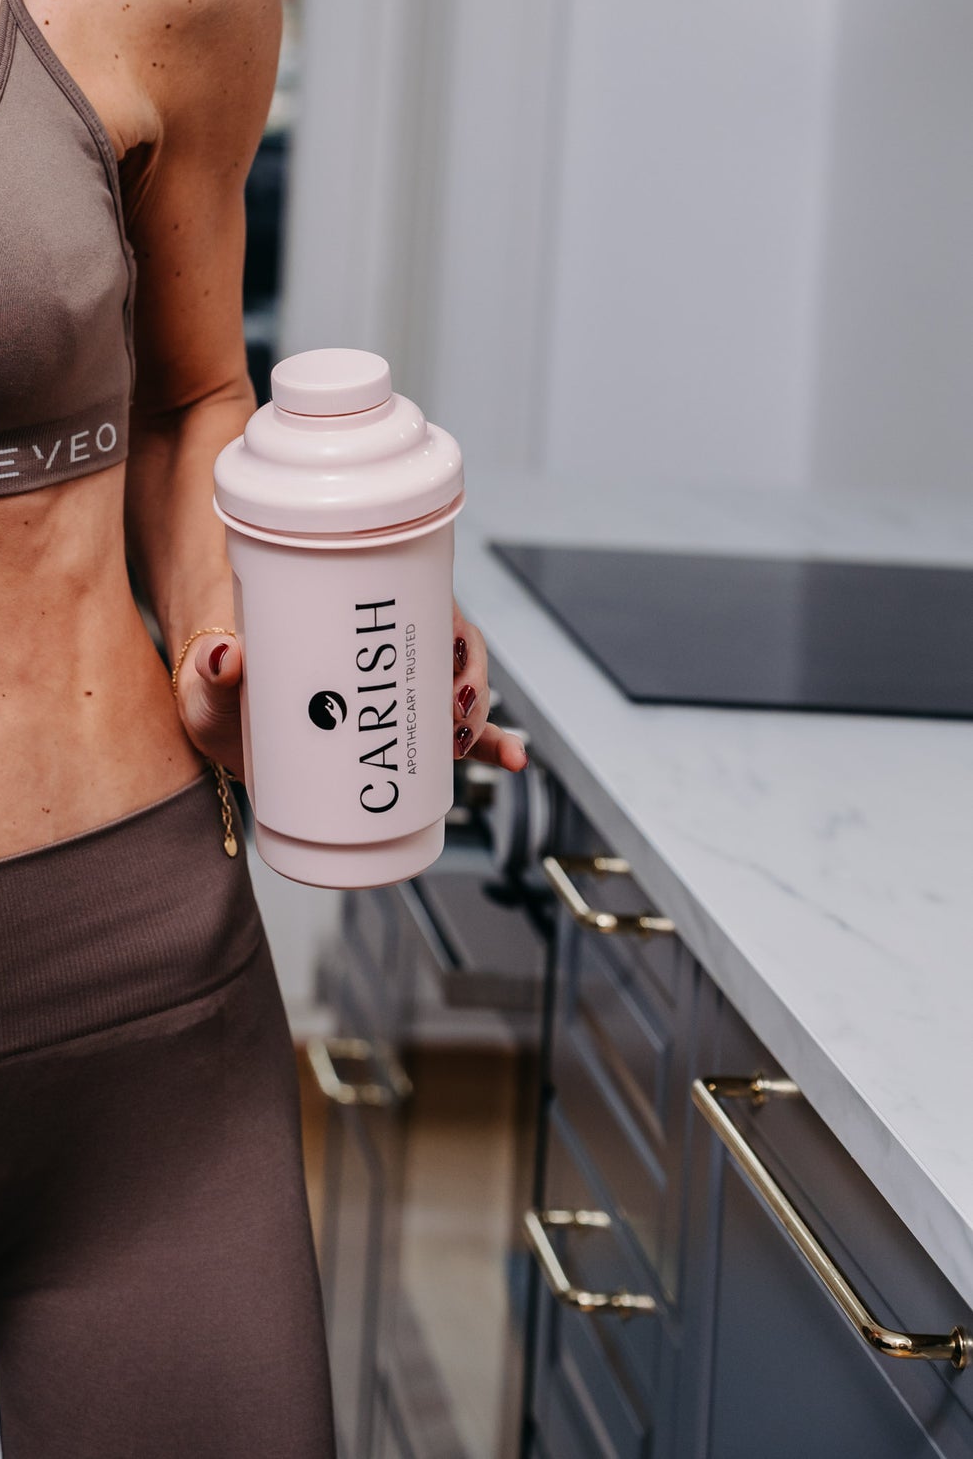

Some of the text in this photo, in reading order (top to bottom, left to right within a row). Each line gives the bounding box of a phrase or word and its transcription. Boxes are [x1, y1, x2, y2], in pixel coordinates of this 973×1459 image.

[355, 598, 400, 814] CARISH
[405, 622, 418, 775] APOTHECARY TRUSTED
